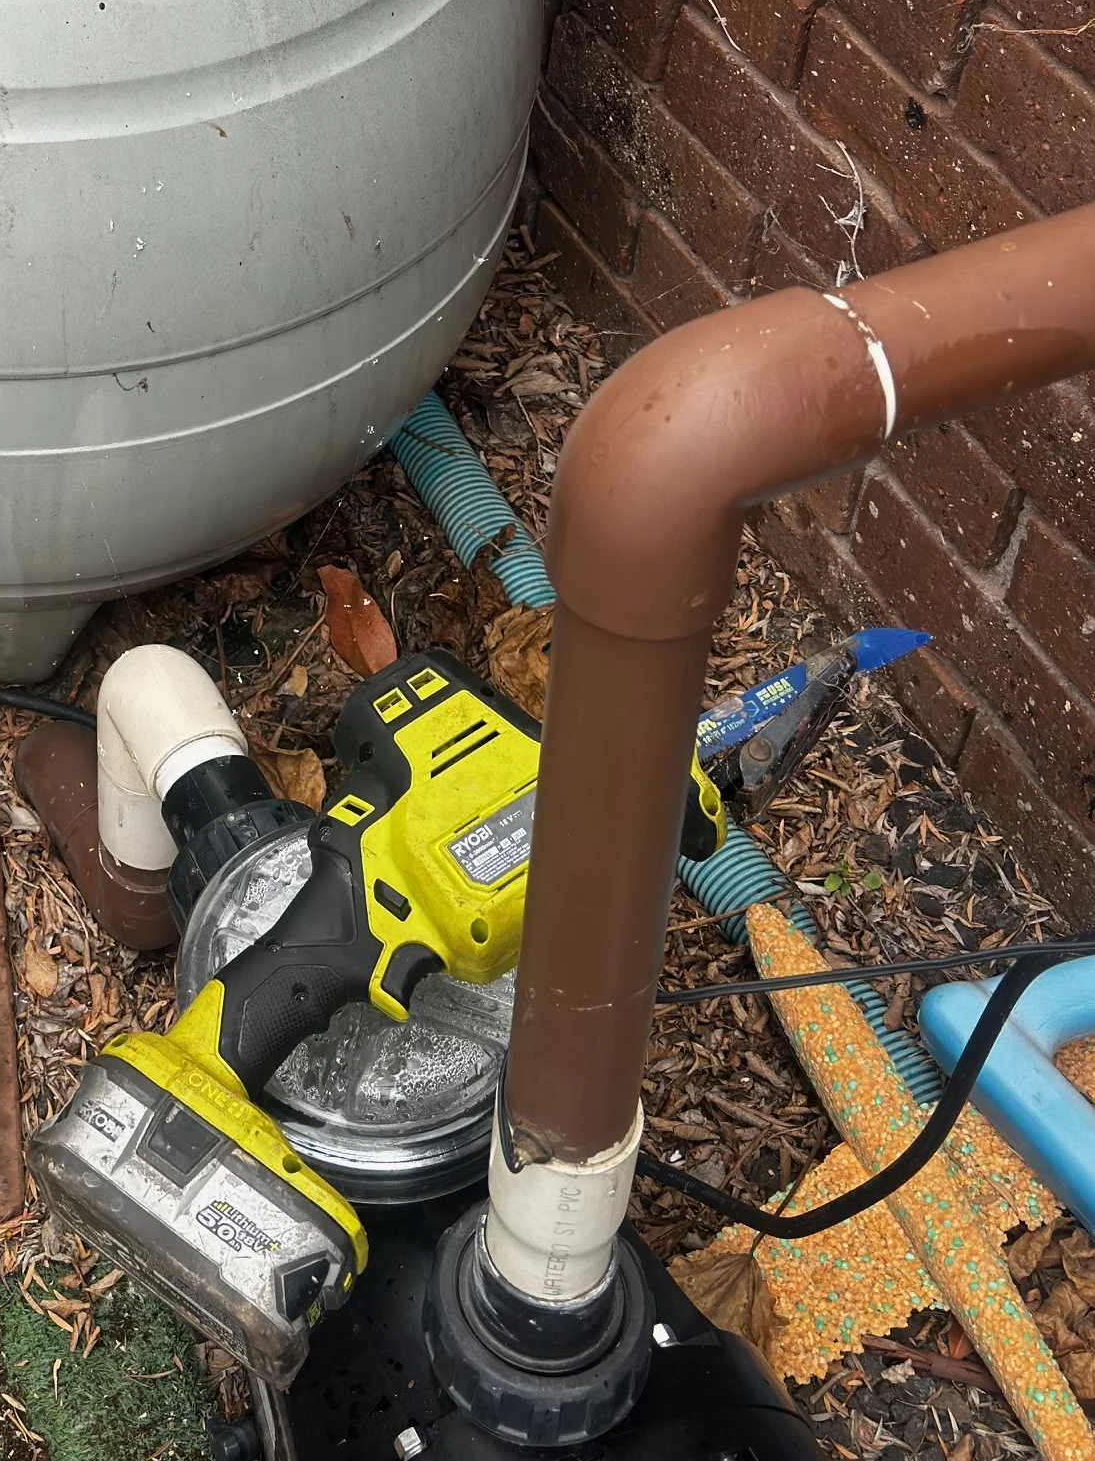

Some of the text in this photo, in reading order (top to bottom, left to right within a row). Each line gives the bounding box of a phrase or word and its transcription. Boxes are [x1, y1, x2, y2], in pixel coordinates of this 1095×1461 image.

[766, 678, 790, 695] USA
[451, 824, 493, 857] RYOBI
[557, 1186, 581, 1212] PVC
[237, 1230, 265, 1253] 18V
